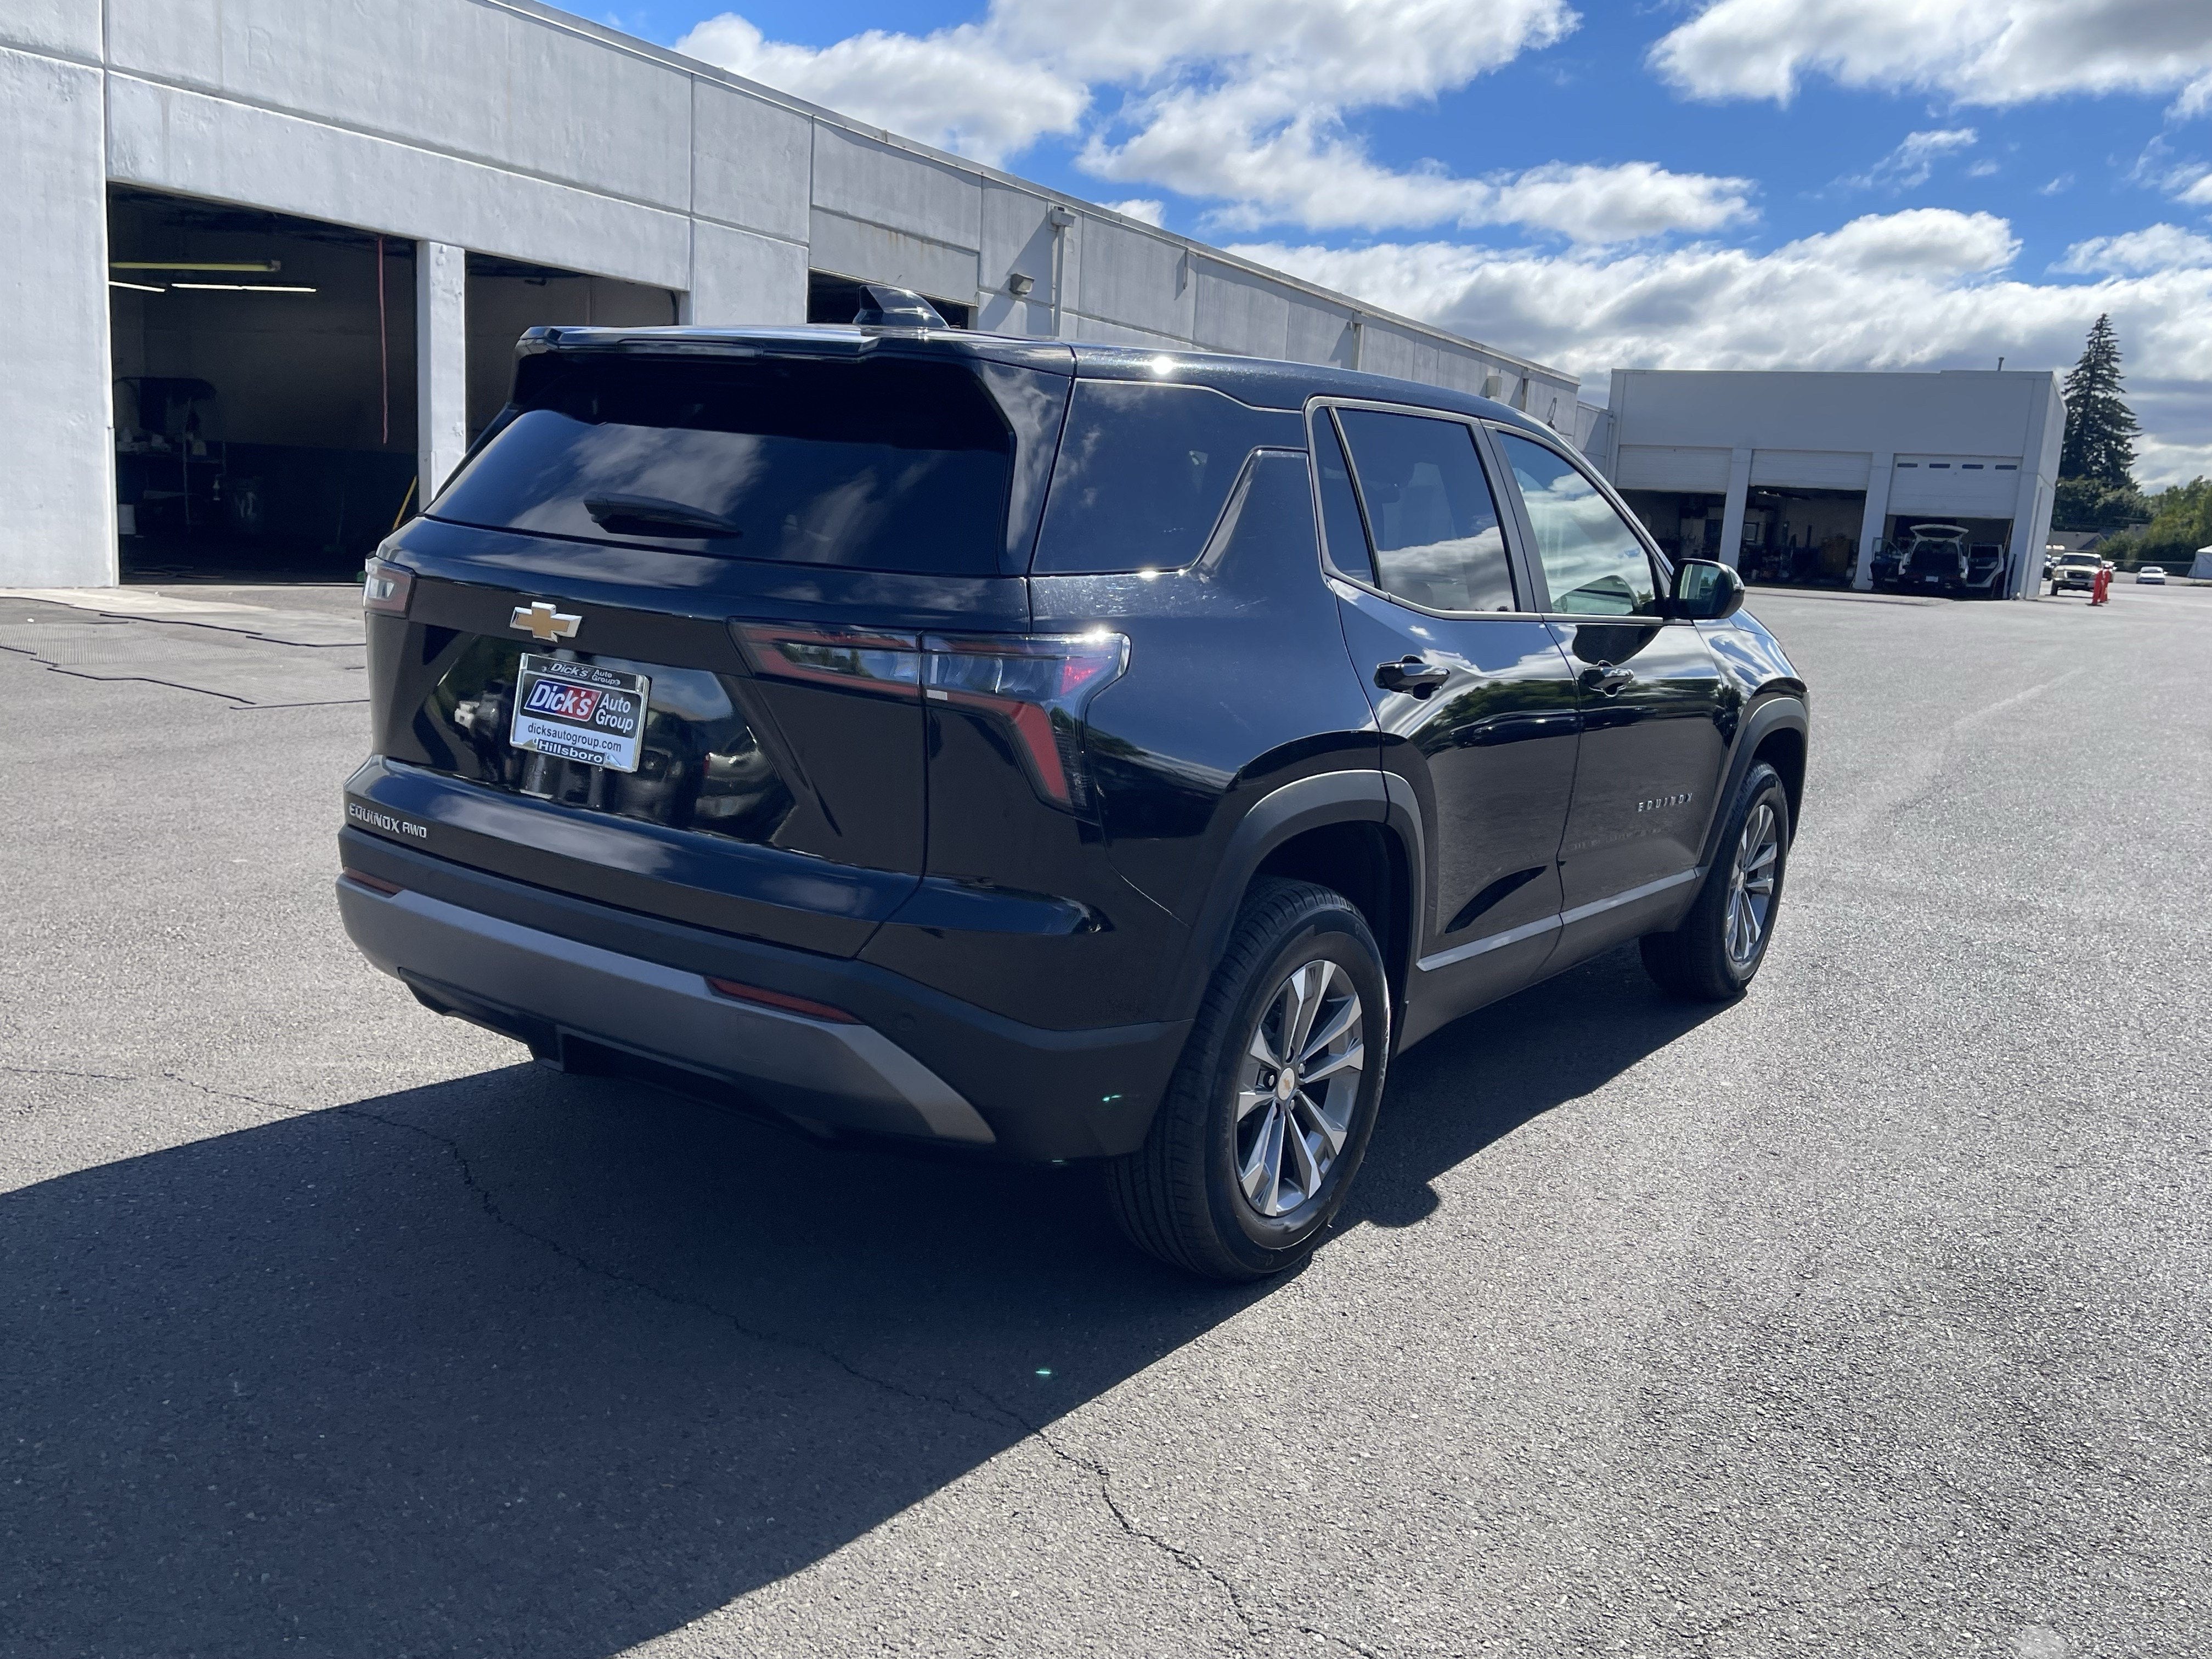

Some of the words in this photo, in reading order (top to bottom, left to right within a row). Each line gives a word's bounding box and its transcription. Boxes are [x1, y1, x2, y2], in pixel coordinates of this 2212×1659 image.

[551, 663, 589, 678] Dick's
[591, 674, 617, 686] Group
[593, 669, 613, 678] Auto
[530, 684, 592, 716] Dick's
[599, 693, 631, 713] Auto
[595, 709, 634, 733] Group
[528, 723, 622, 752] dicksautogroup.com
[538, 741, 603, 763] Hillsboro
[1638, 792, 1693, 812] EQUINOX
[348, 802, 400, 834] EQUINOX
[402, 822, 427, 839] AWD
